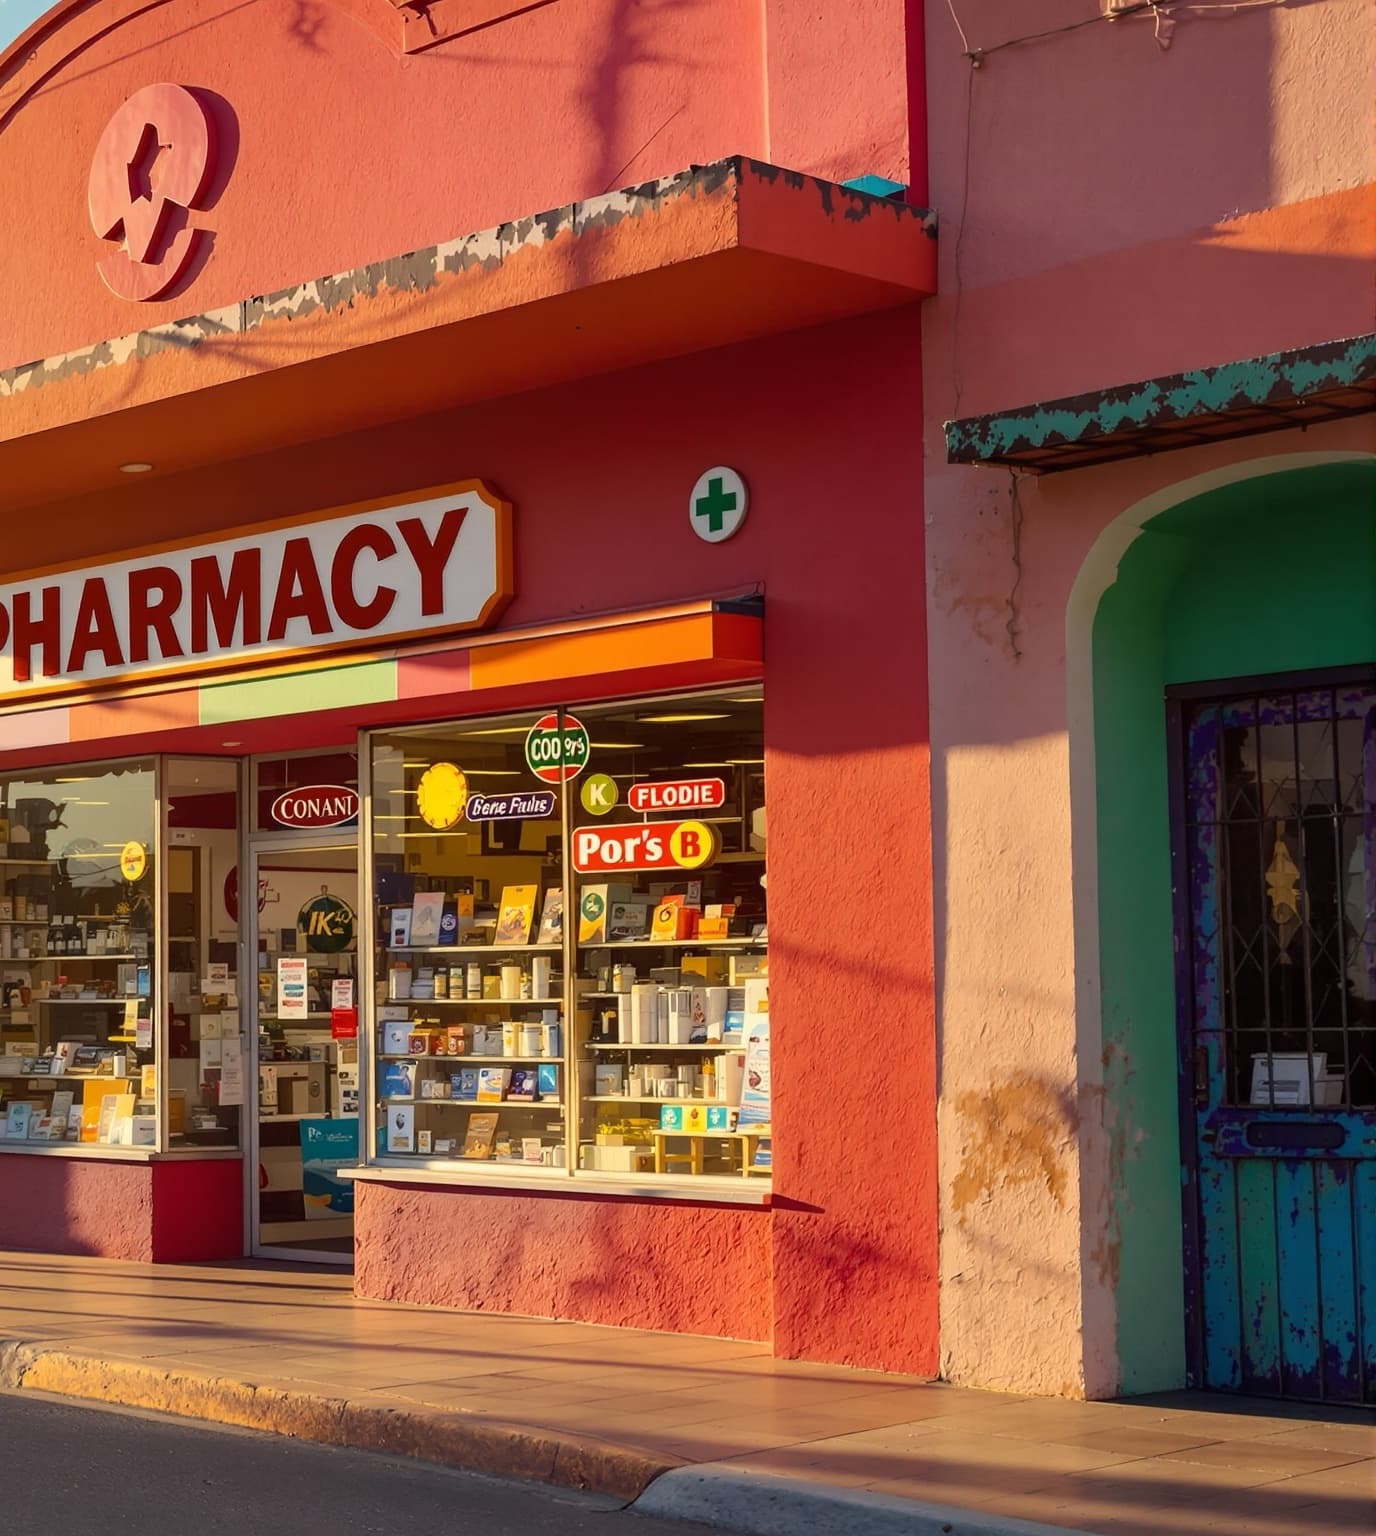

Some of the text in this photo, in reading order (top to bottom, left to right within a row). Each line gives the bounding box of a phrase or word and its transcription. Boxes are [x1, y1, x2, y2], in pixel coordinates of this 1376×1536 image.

[280, 795, 354, 820] CONANT
[636, 784, 715, 808] FLODIE
[680, 831, 701, 859] B
